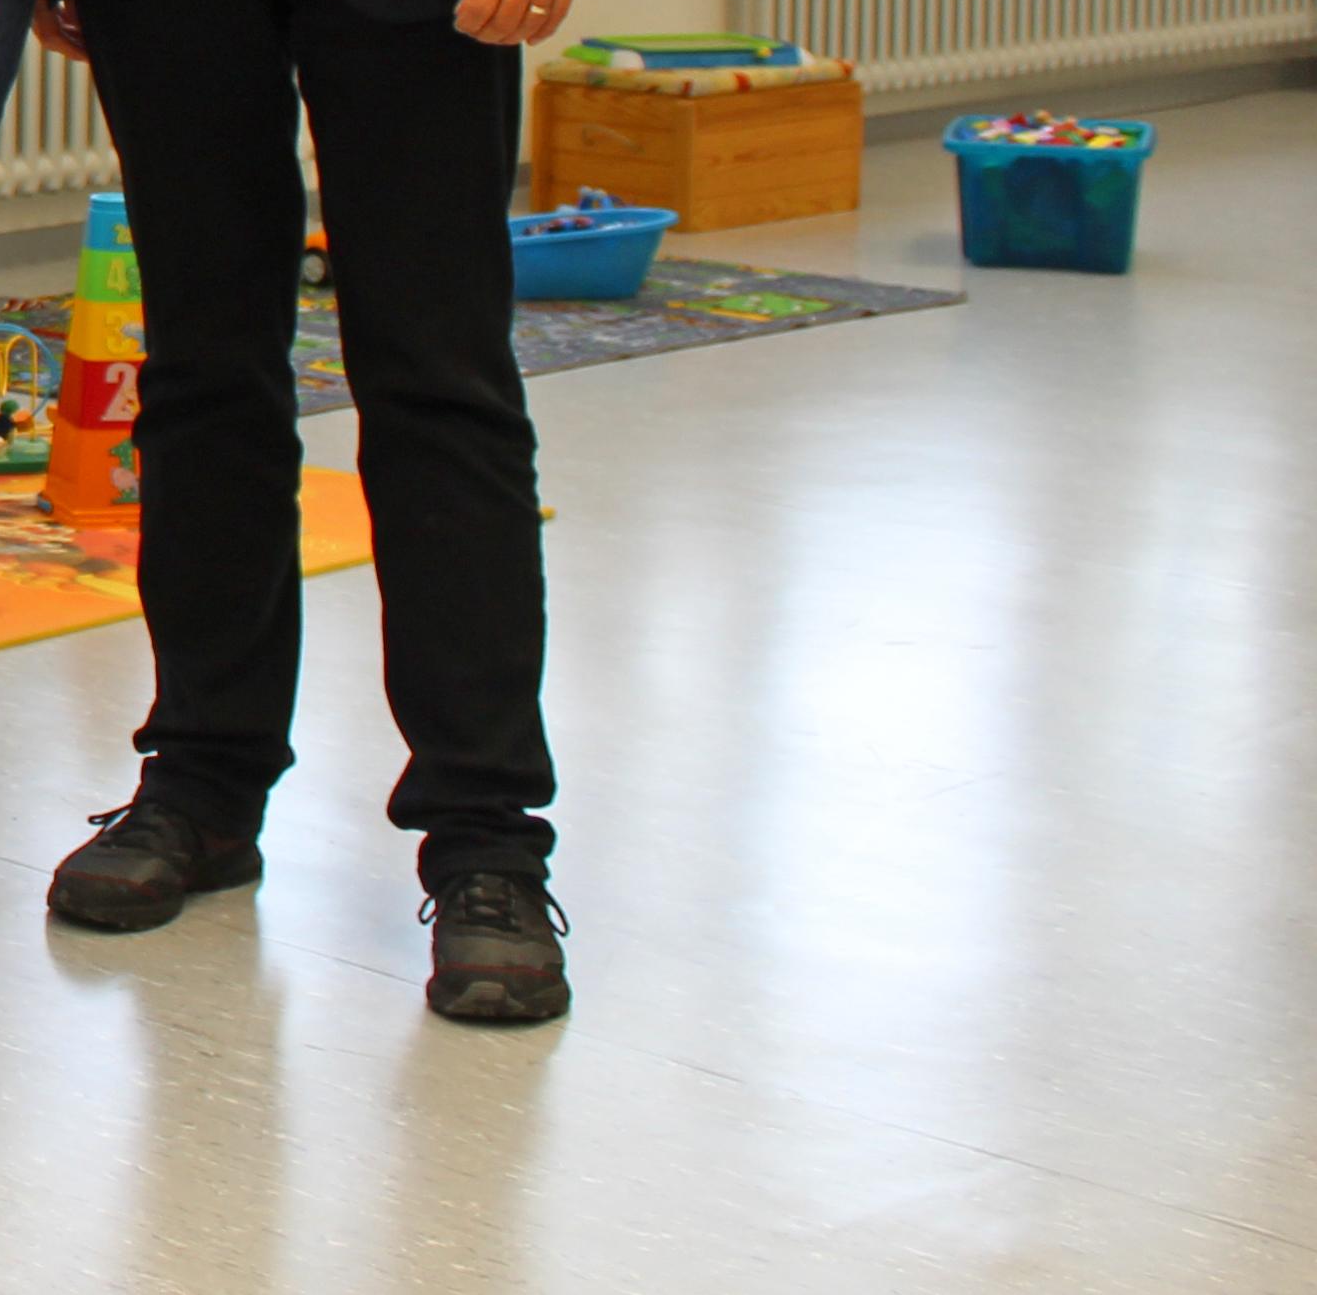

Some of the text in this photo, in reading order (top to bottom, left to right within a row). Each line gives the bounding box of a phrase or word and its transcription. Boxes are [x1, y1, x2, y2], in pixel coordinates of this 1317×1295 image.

[107, 258, 129, 296] 4
[104, 312, 131, 354] 3
[101, 362, 139, 422] 2
